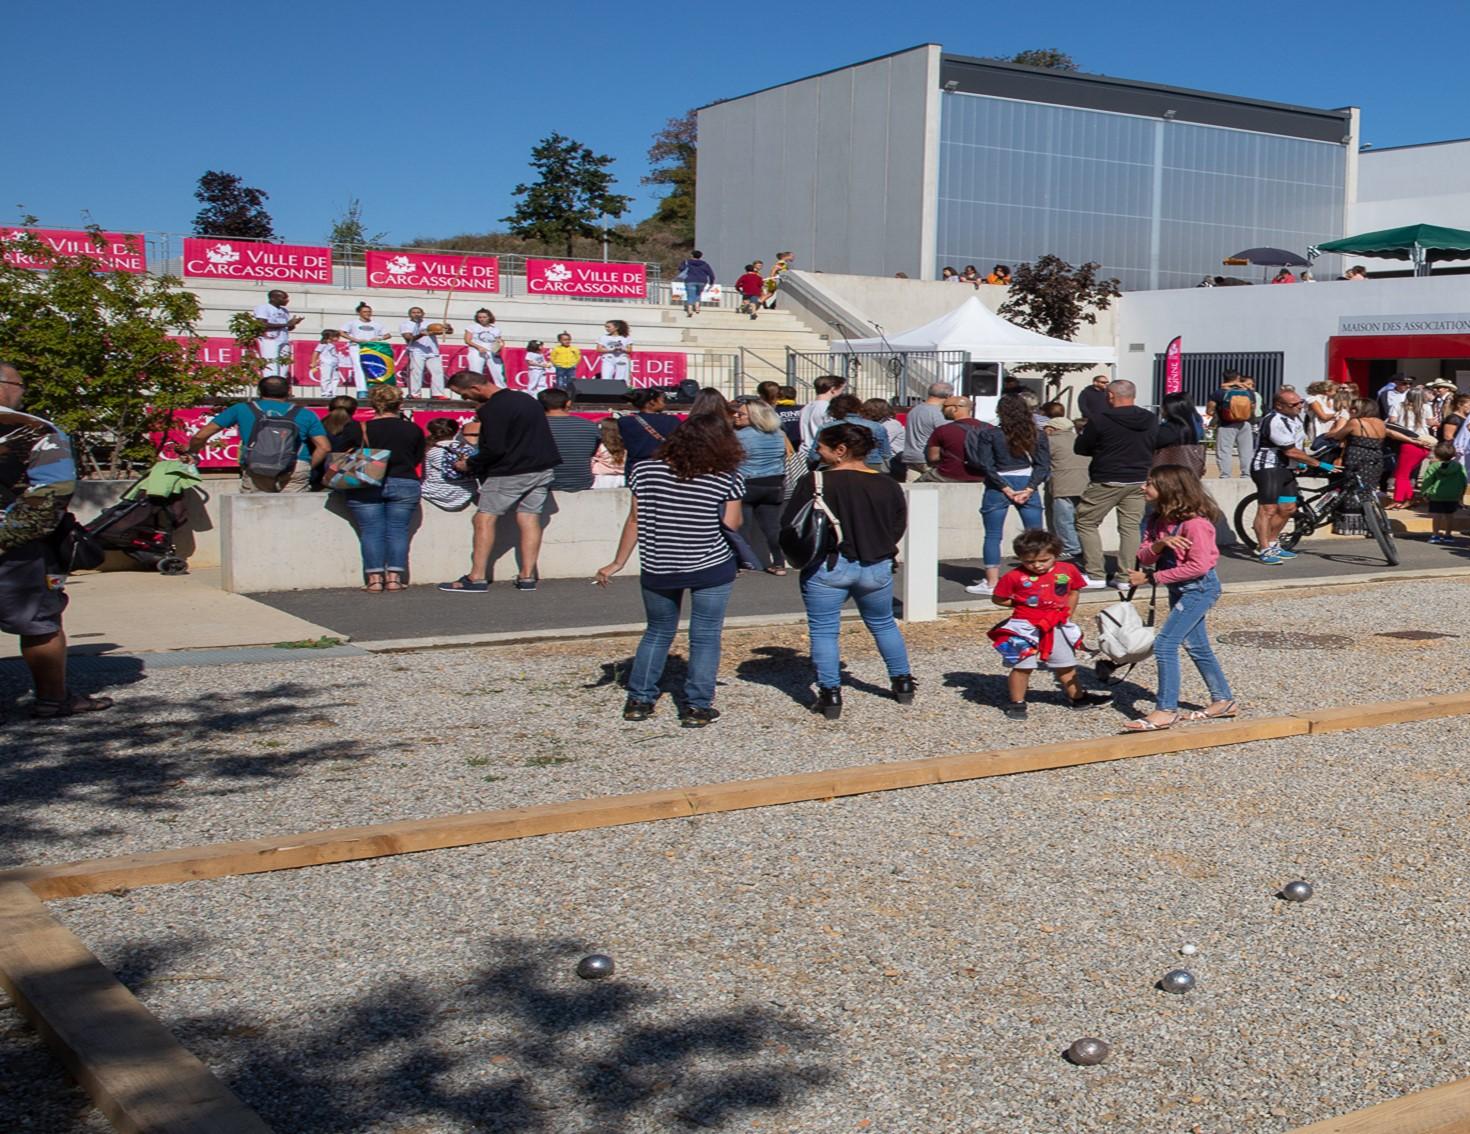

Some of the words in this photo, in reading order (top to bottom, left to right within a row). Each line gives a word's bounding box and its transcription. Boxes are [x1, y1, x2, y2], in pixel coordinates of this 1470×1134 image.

[247, 250, 298, 266] VILLE
[303, 255, 327, 268] DE
[187, 260, 327, 280] CARCASSONNE
[422, 261, 468, 276] VILLE
[472, 266, 494, 277] DE
[577, 269, 618, 283] VILLE
[623, 273, 642, 283] DE
[369, 271, 495, 289] CARCASSONNE
[530, 278, 644, 294] CARCASSONNE
[1342, 321, 1379, 332] MAISON
[1382, 321, 1402, 331] DES
[647, 359, 674, 374] DE
